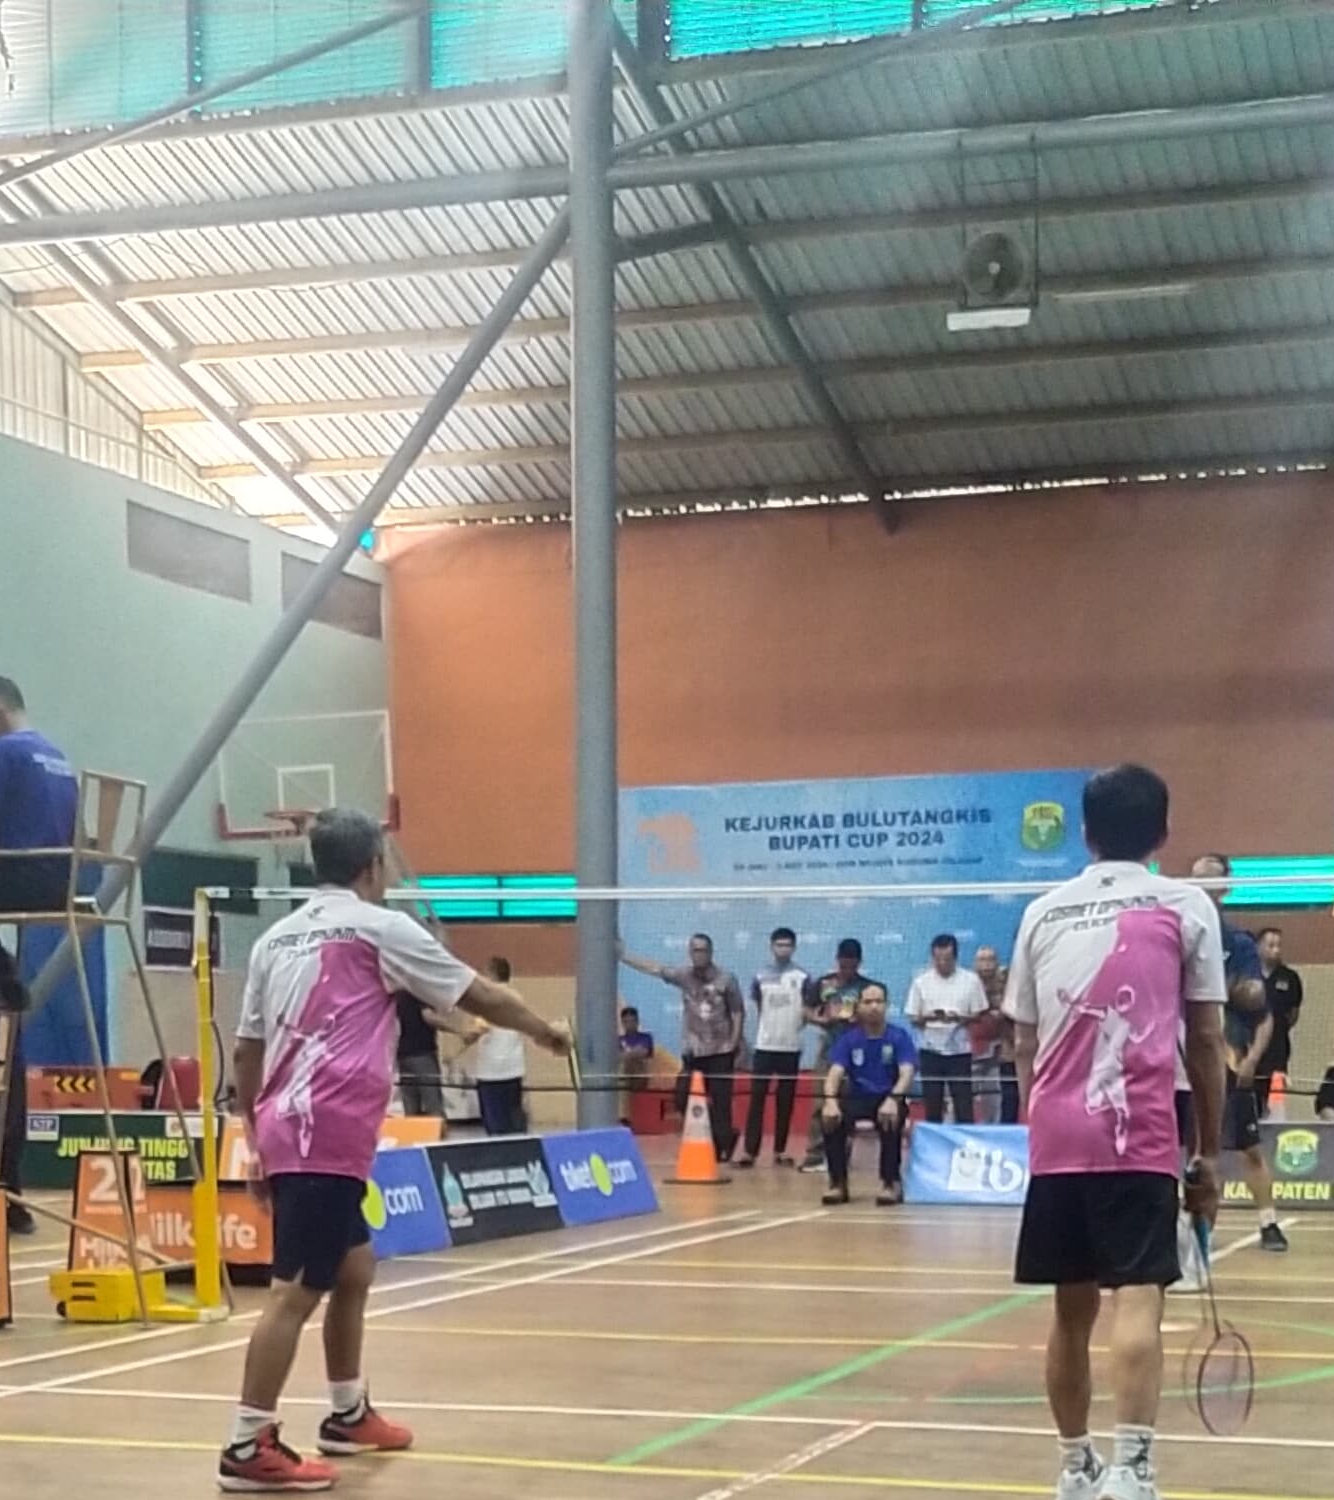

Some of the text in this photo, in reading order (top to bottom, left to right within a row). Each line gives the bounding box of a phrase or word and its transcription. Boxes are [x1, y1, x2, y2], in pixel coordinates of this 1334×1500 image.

[724, 808, 993, 833] KEJURKAB BULUTANGKIS
[768, 830, 945, 851] BUPATI CUP 2024
